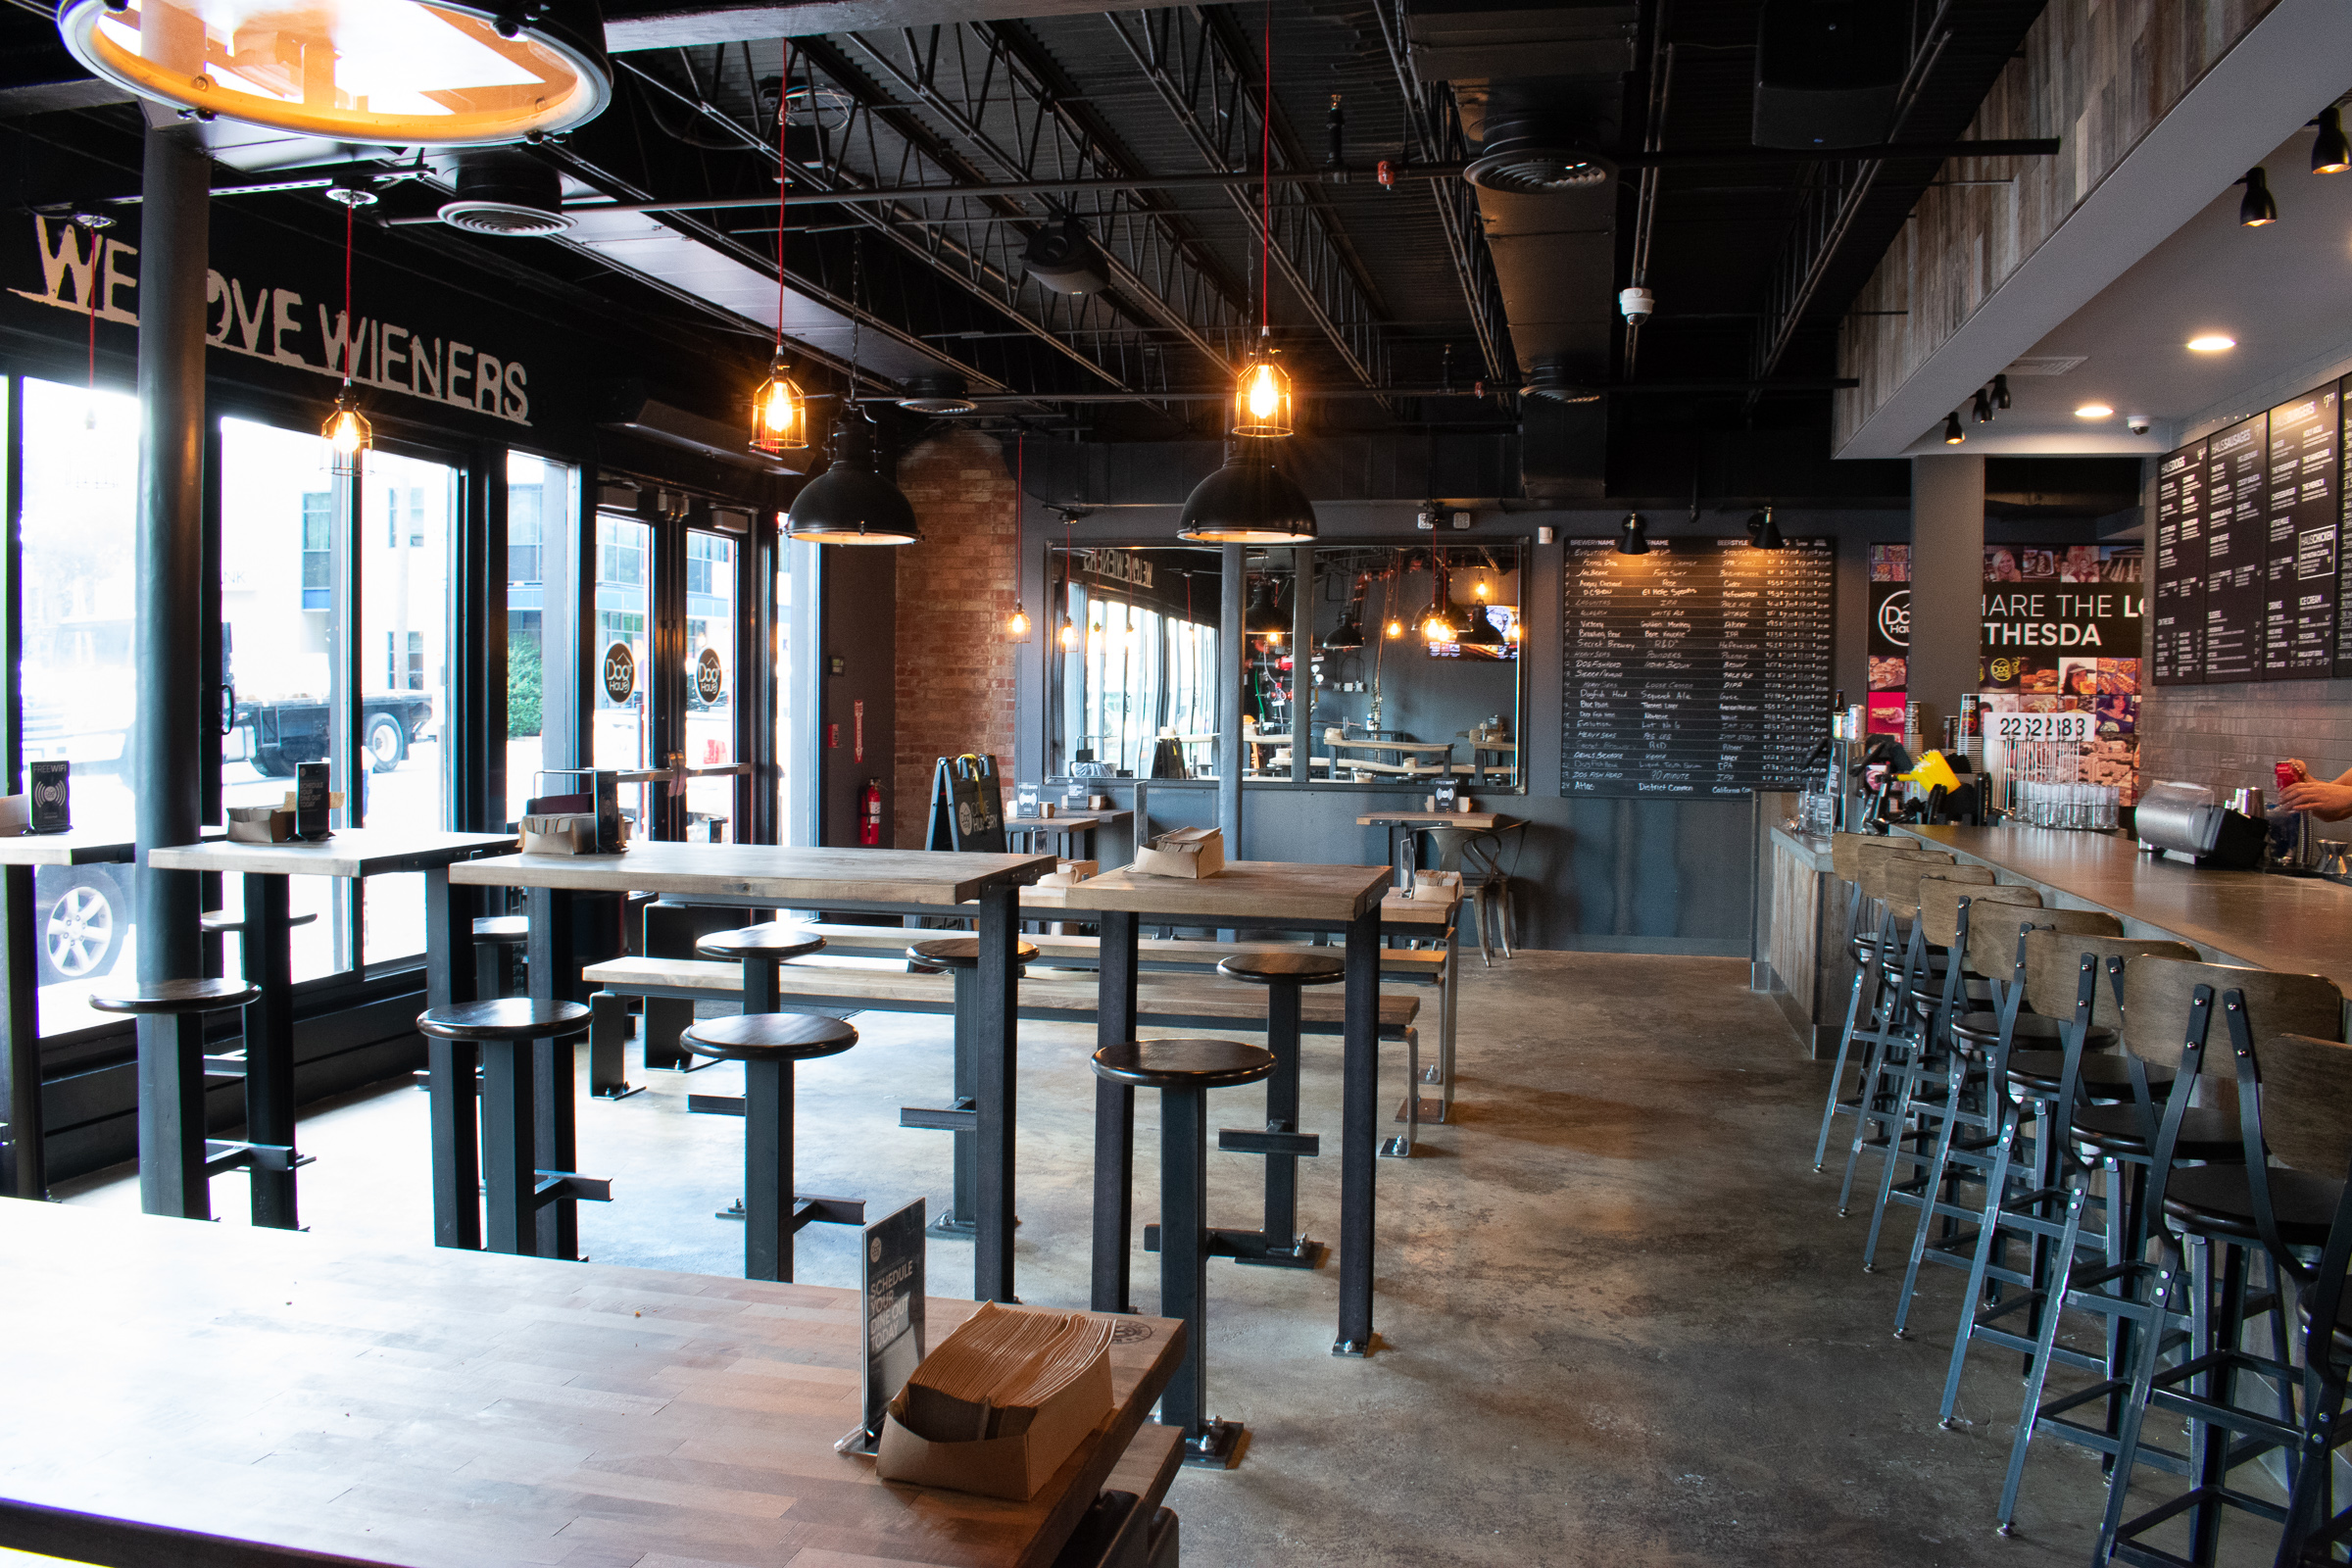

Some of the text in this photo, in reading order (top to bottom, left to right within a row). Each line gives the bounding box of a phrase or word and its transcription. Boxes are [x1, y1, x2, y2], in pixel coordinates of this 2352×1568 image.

[35, 215, 531, 423] WE OVE WIENERS
[1886, 606, 1910, 624] Do
[1982, 595, 2112, 617] ARE THE
[1581, 620, 1604, 629] Victory
[1981, 622, 2102, 647] THESDA
[607, 658, 632, 683] Dog
[699, 662, 720, 686] Dog
[1716, 773, 1735, 782] IPA
[1717, 761, 1734, 770] IPA
[1574, 781, 1595, 791] Atlas
[1639, 782, 1666, 791] District
[870, 1259, 913, 1299] SCHEDULE
[870, 1290, 894, 1316] YOUR
[870, 1298, 908, 1336] DINE OUT
[870, 1319, 900, 1351] TODAY
